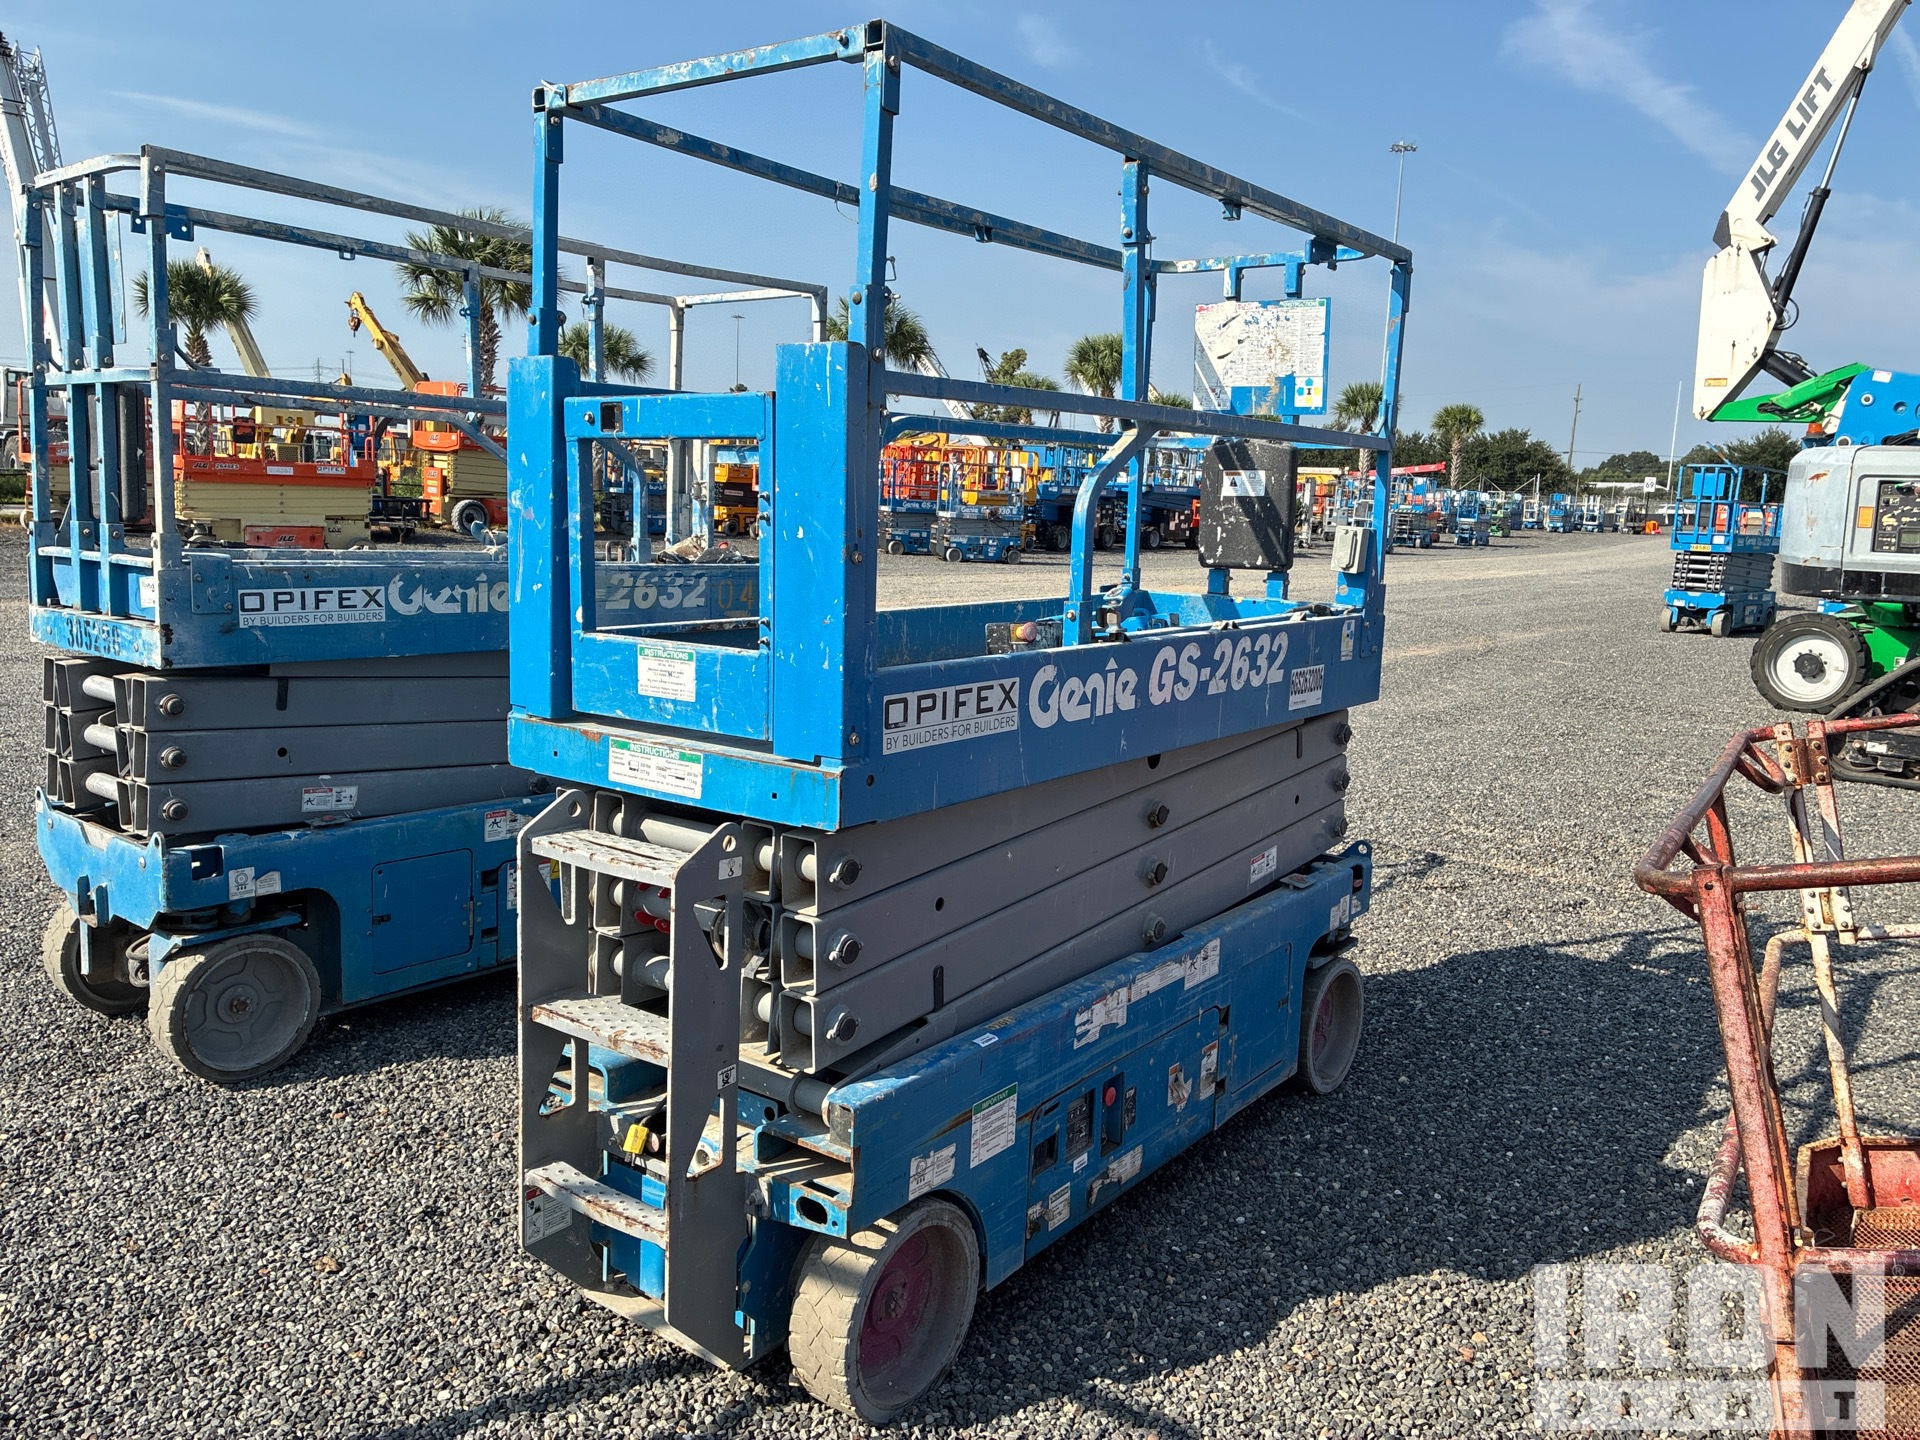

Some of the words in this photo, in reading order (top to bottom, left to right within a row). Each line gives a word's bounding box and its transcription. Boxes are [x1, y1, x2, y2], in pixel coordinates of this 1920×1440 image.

[1750, 140, 1789, 202] JLG
[1785, 66, 1833, 141] LIFT
[1645, 481, 1655, 489] 69
[239, 589, 384, 613] OPIFEX
[387, 572, 509, 616] Genie
[242, 617, 257, 626] BY
[260, 614, 310, 625] BUILDERS
[313, 613, 335, 623] FOR
[337, 611, 383, 622] BUILDERS
[643, 648, 689, 660] INSTRUCTIONS
[1028, 657, 1138, 729] Genie
[1149, 631, 1289, 706] GS-2632
[884, 681, 1017, 730] OPIFEX
[886, 735, 899, 750] BY
[902, 727, 949, 747] BUILDERS
[952, 723, 971, 737] FOR
[974, 715, 1016, 734] BUILDERS
[629, 743, 680, 760] INSTRUCTIONS
[982, 1090, 1009, 1110] IMPORTANT
